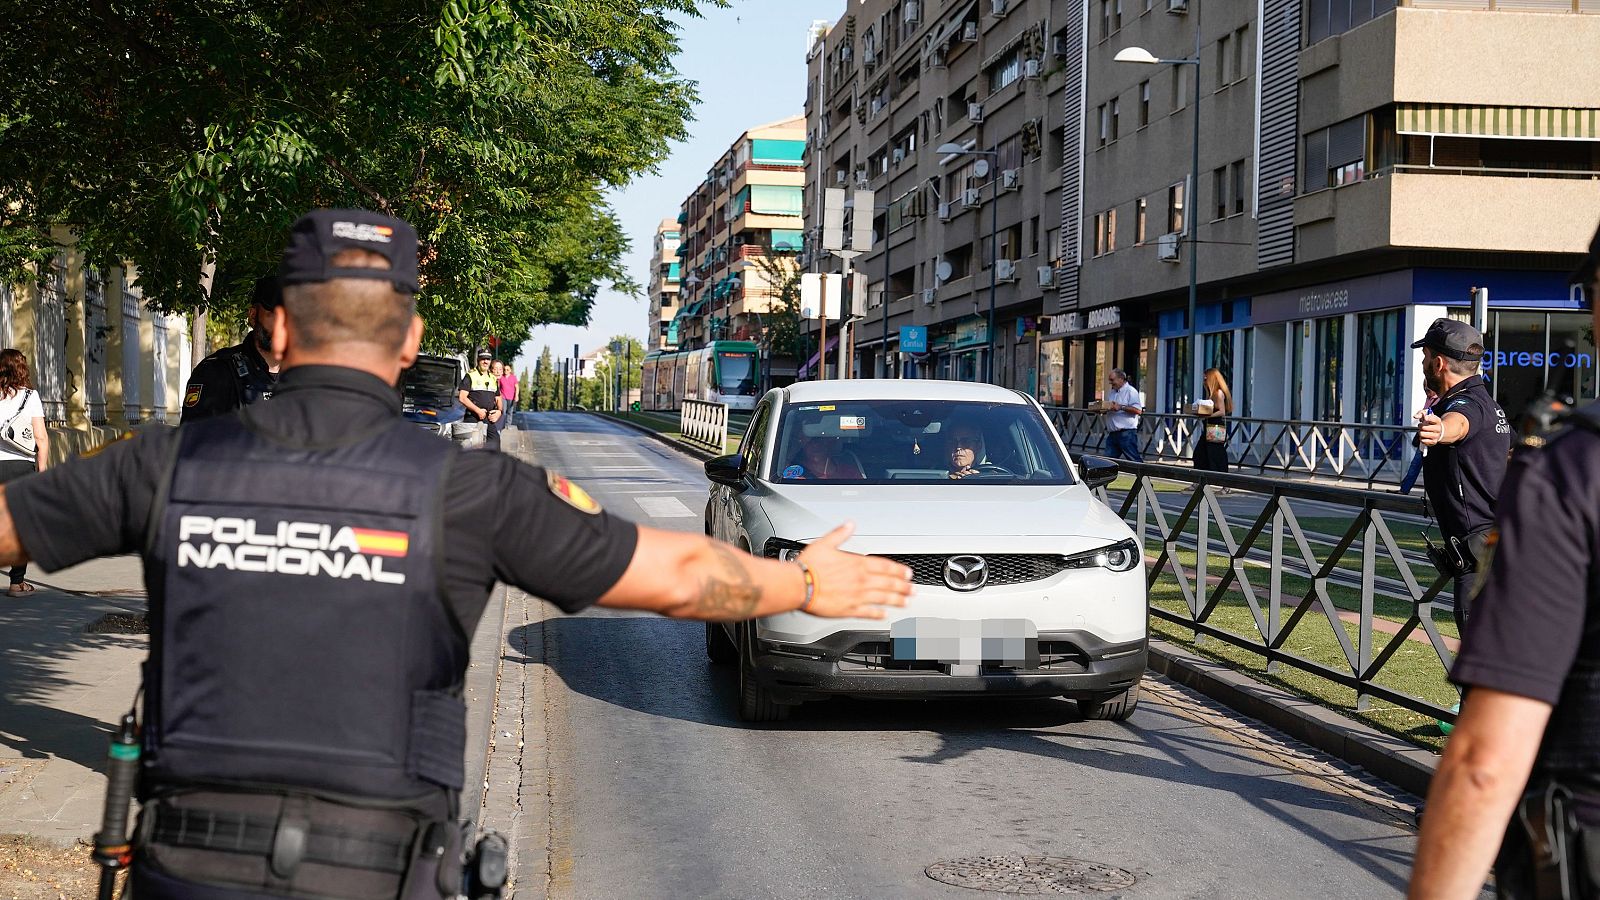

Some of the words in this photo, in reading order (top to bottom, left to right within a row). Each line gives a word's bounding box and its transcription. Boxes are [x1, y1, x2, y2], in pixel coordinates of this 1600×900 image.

[1299, 289, 1349, 313] metrovacesa
[1087, 305, 1117, 329] ABOGADOS
[179, 515, 361, 553] POLICIA
[178, 542, 405, 584] NACIONAL
